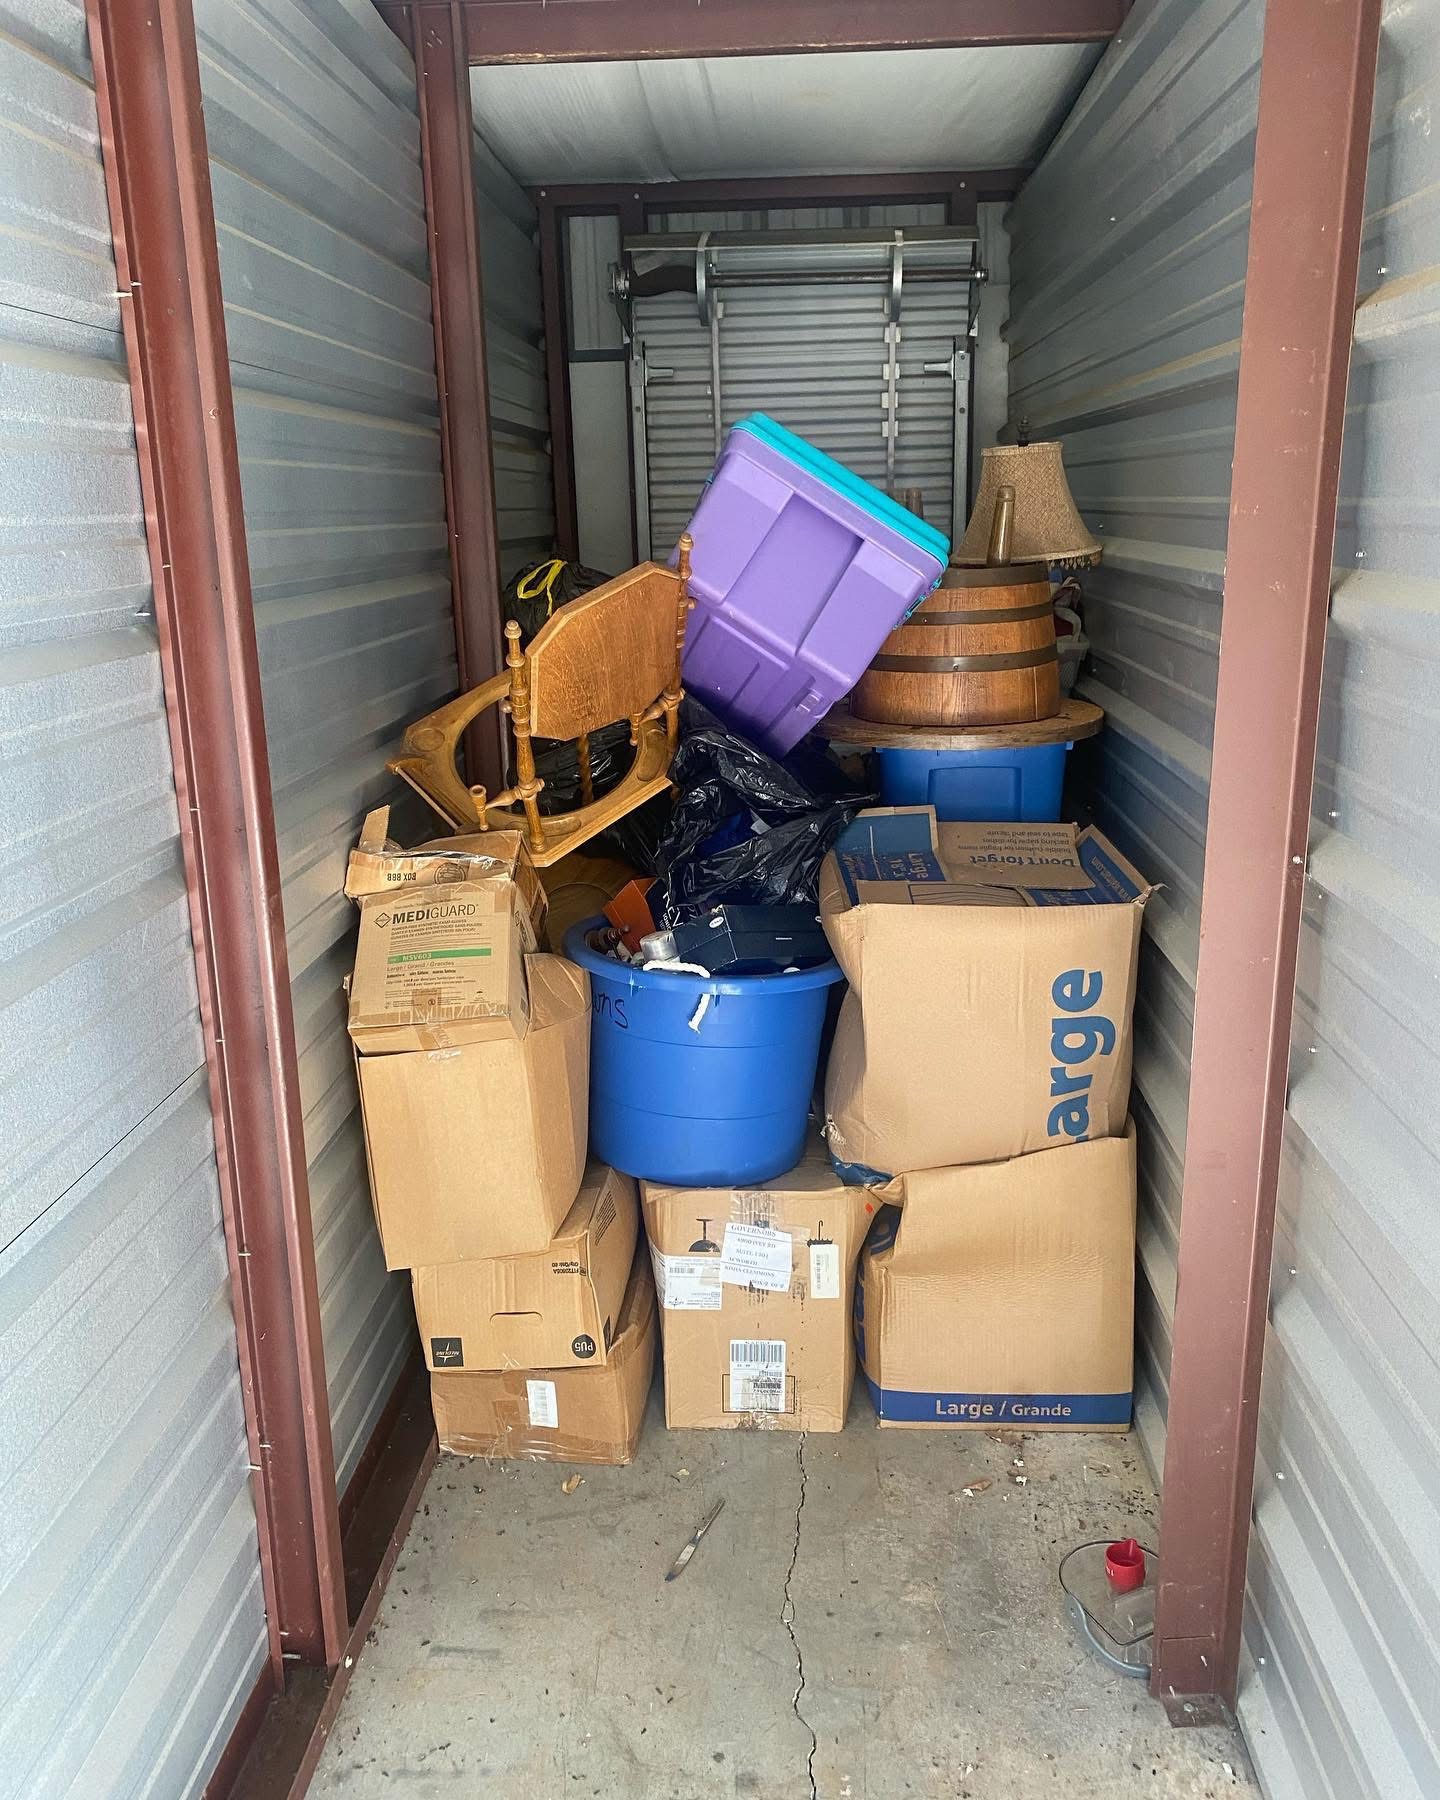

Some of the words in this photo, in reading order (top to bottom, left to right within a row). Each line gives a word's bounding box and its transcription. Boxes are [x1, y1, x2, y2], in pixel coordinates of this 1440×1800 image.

[908, 852, 929, 879] Large
[970, 854, 1025, 866] forget
[392, 904, 476, 925] MEDIGUARD
[402, 953, 432, 962] MSV603
[1046, 968, 1117, 1142] arge
[731, 1224, 777, 1237] GOVERNORS
[574, 1341, 594, 1352] PU5
[935, 1399, 994, 1419] Large
[998, 1400, 1006, 1417] /
[1011, 1402, 1072, 1417] Grande
